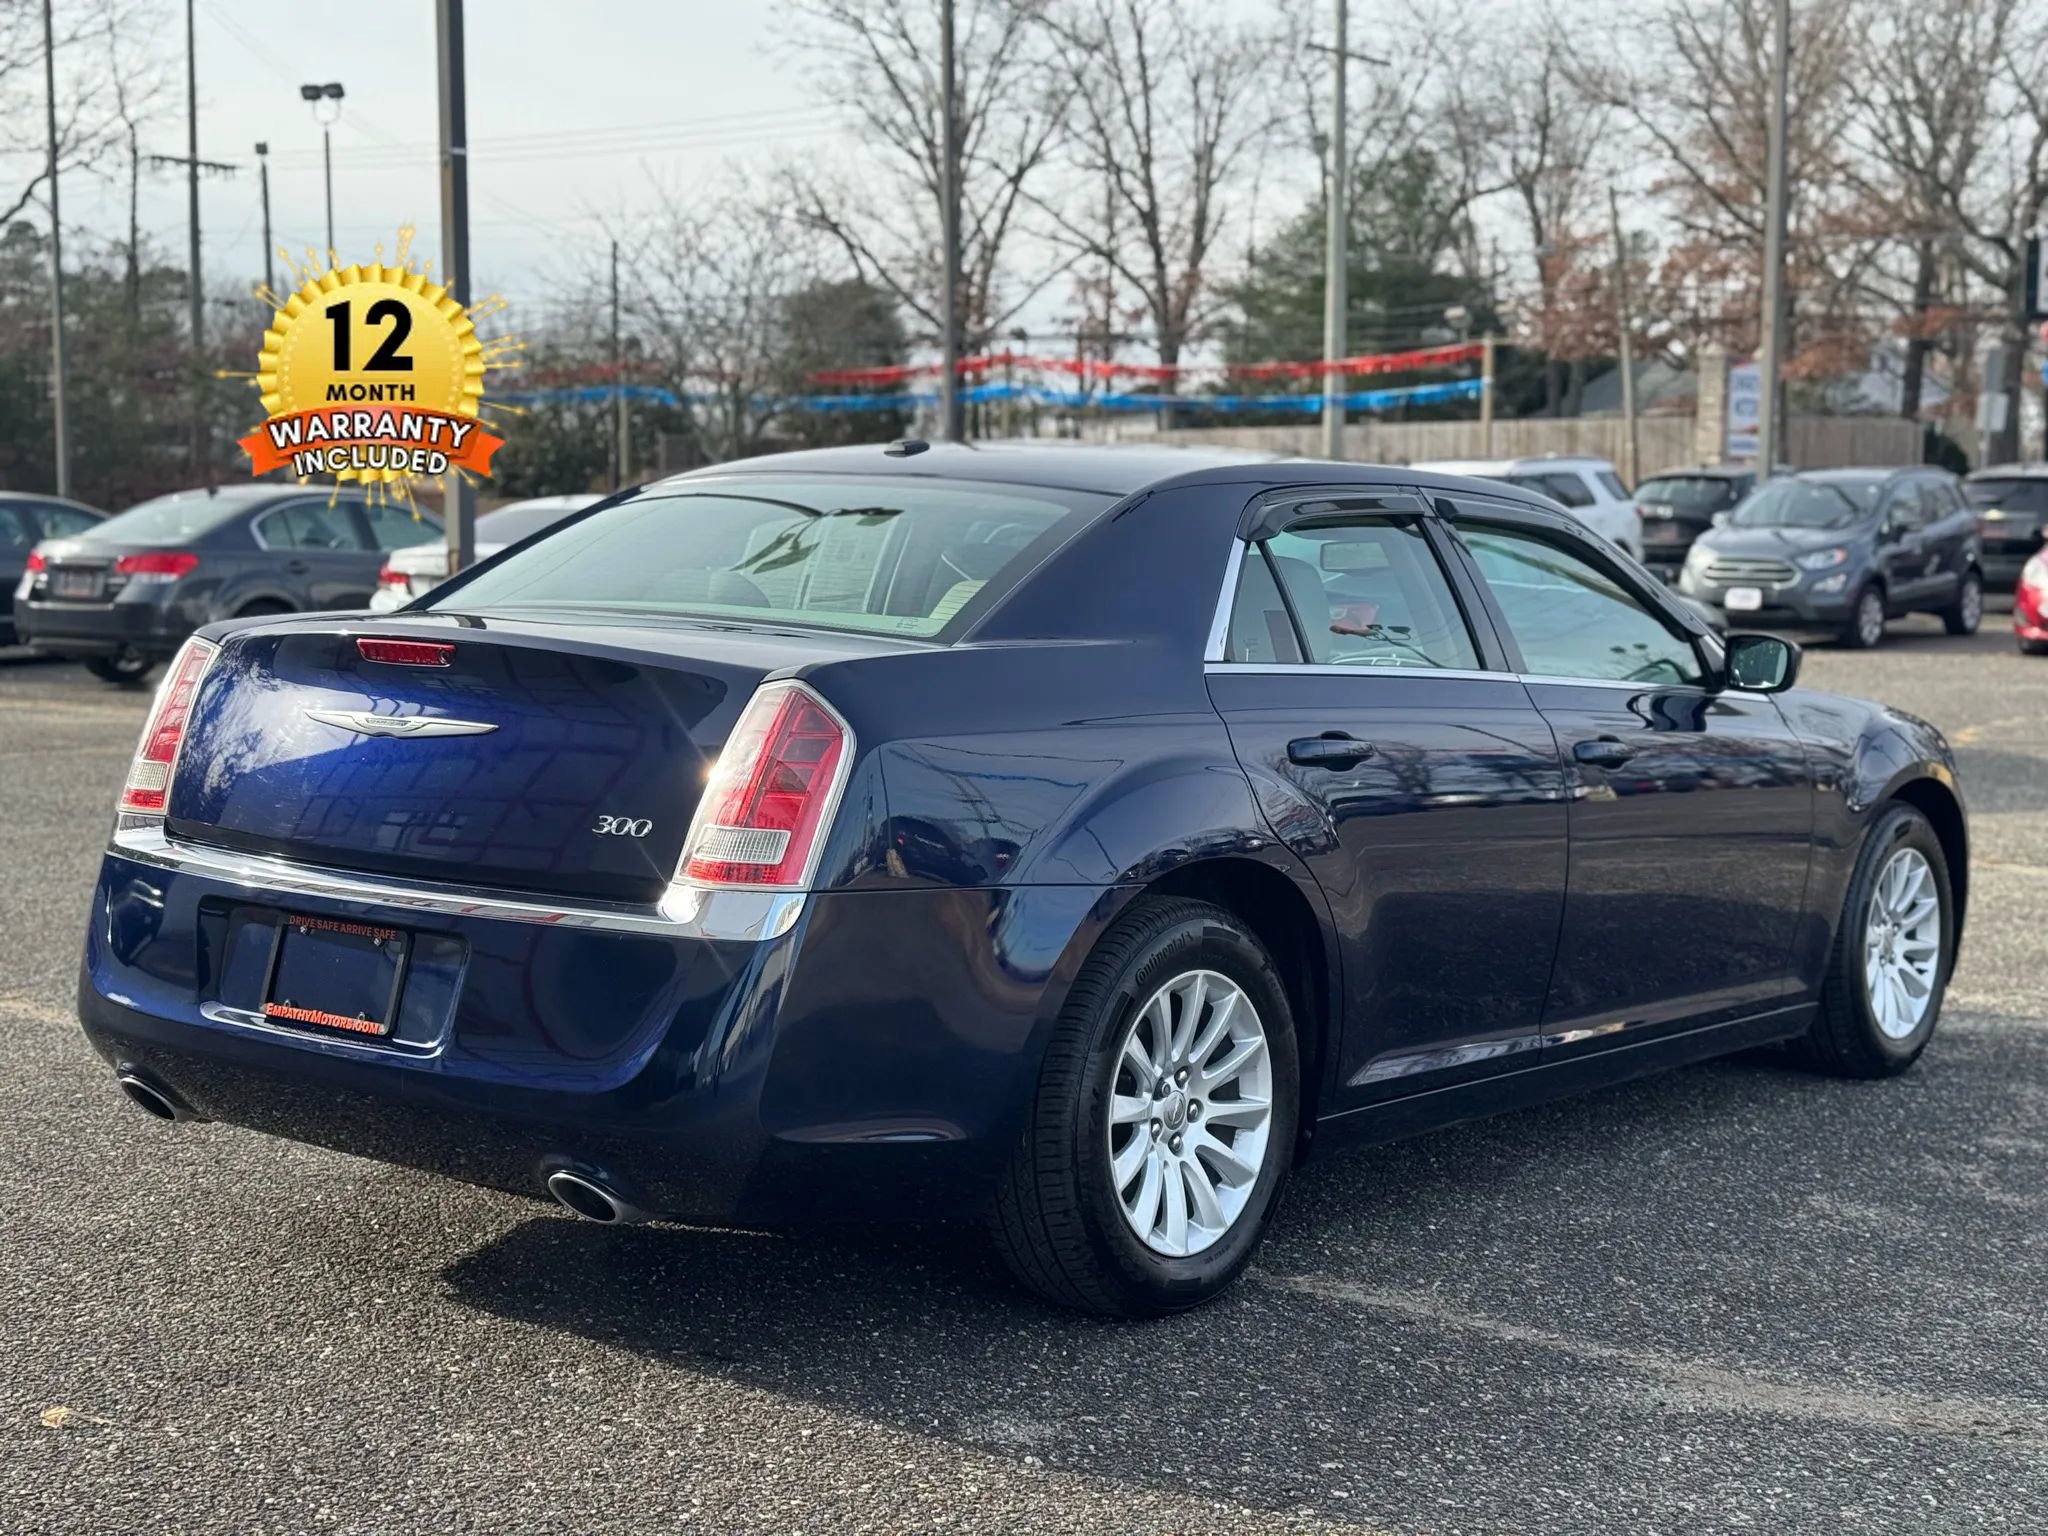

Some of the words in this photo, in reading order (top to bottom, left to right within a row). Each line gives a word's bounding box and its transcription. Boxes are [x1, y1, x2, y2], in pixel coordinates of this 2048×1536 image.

[592, 815, 653, 837] 300
[289, 915, 316, 927] DRIVE
[317, 919, 339, 931] SAFE
[339, 923, 373, 936] ARRIVE
[373, 928, 396, 939] SAFE
[1135, 932, 1186, 986] Continental
